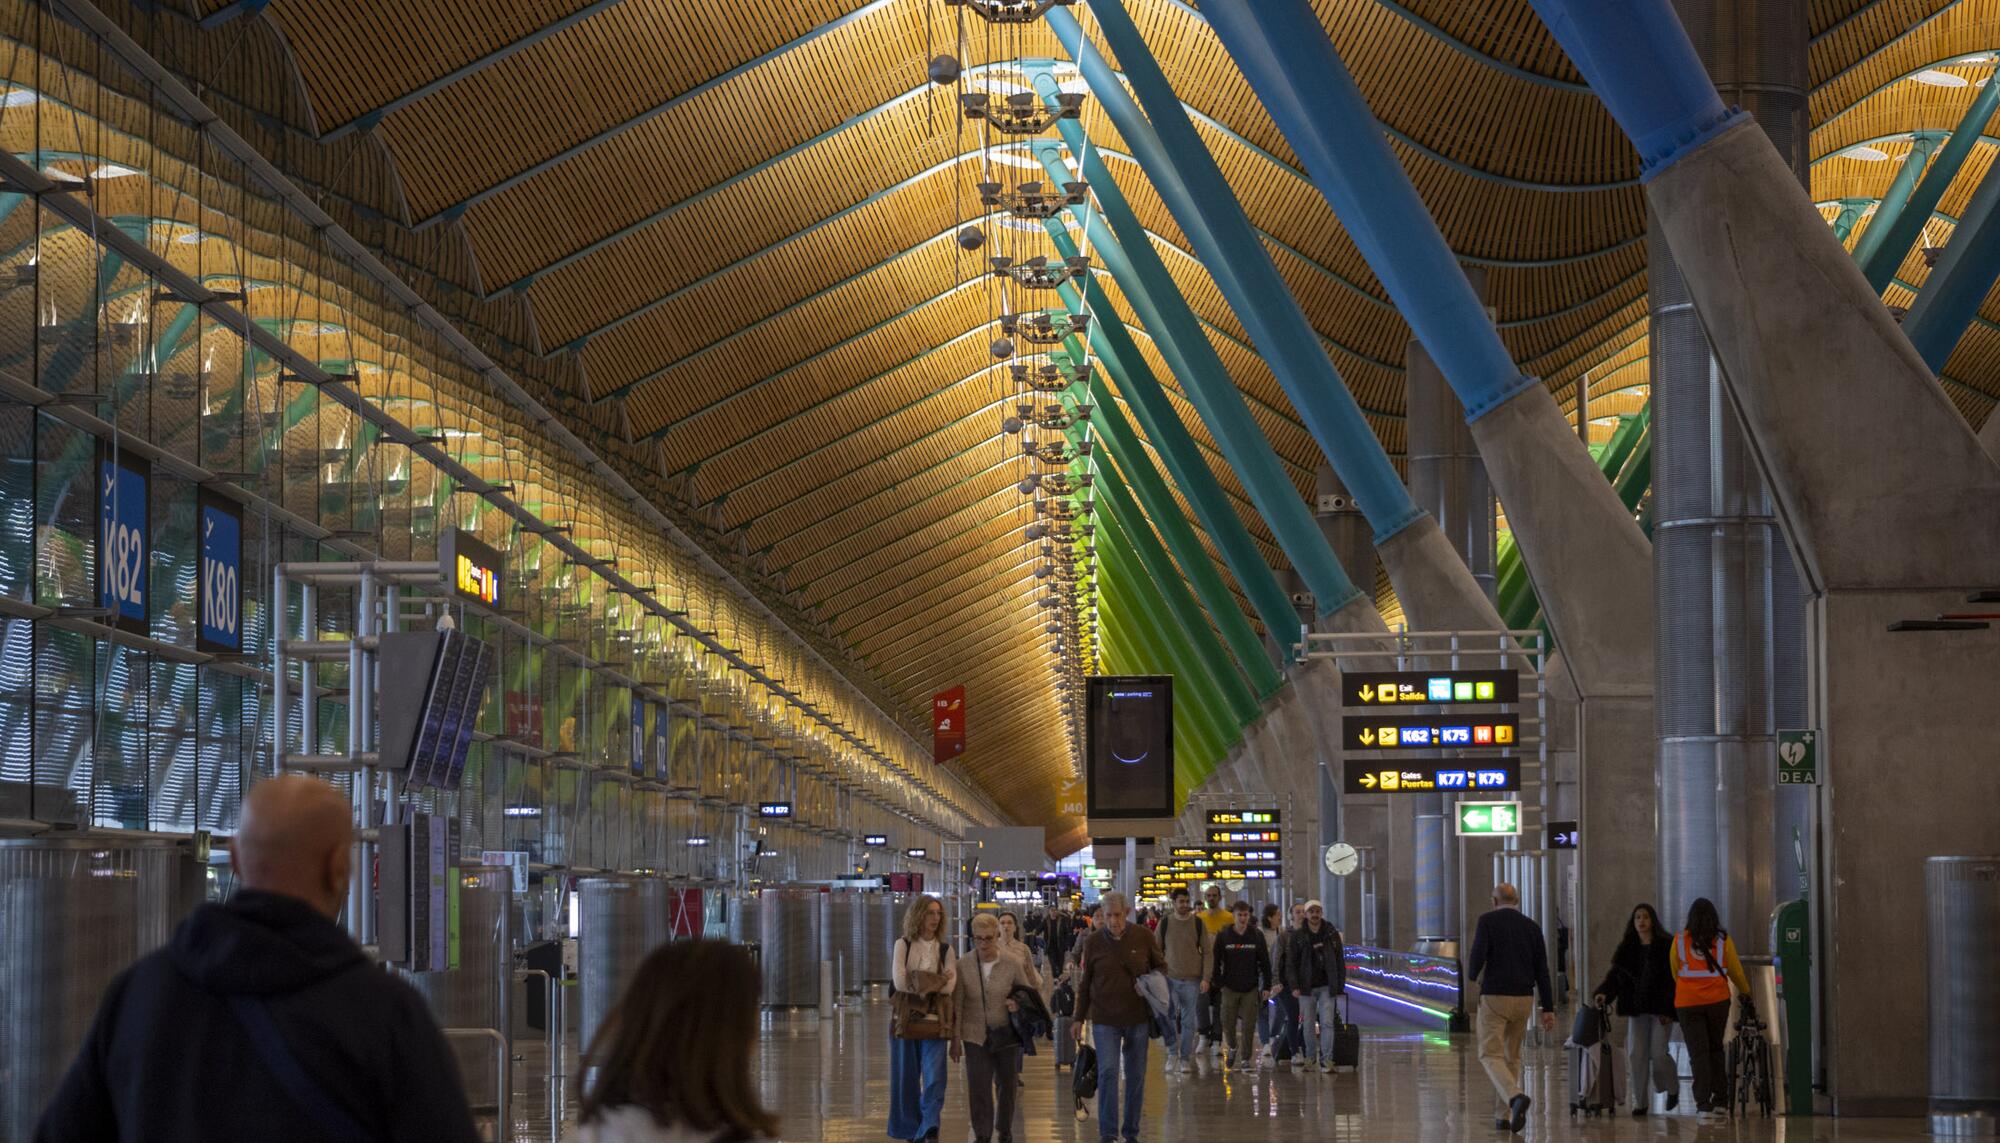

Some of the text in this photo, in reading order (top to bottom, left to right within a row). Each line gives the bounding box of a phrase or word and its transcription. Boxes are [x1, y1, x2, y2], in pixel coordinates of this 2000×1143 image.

[104, 518, 142, 604] K82
[205, 556, 237, 634] K80
[1399, 684, 1413, 692] Exit
[1399, 692, 1426, 701] Salida
[1402, 730, 1429, 742] K62
[1431, 728, 1439, 736] to
[1442, 729, 1469, 742] K75
[1477, 729, 1488, 741] H
[1401, 772, 1421, 780] Gates
[1438, 771, 1505, 786] K77 to K79
[1780, 771, 1814, 783] DEA
[1401, 780, 1434, 789] Puertas
[1061, 803, 1083, 814] J40
